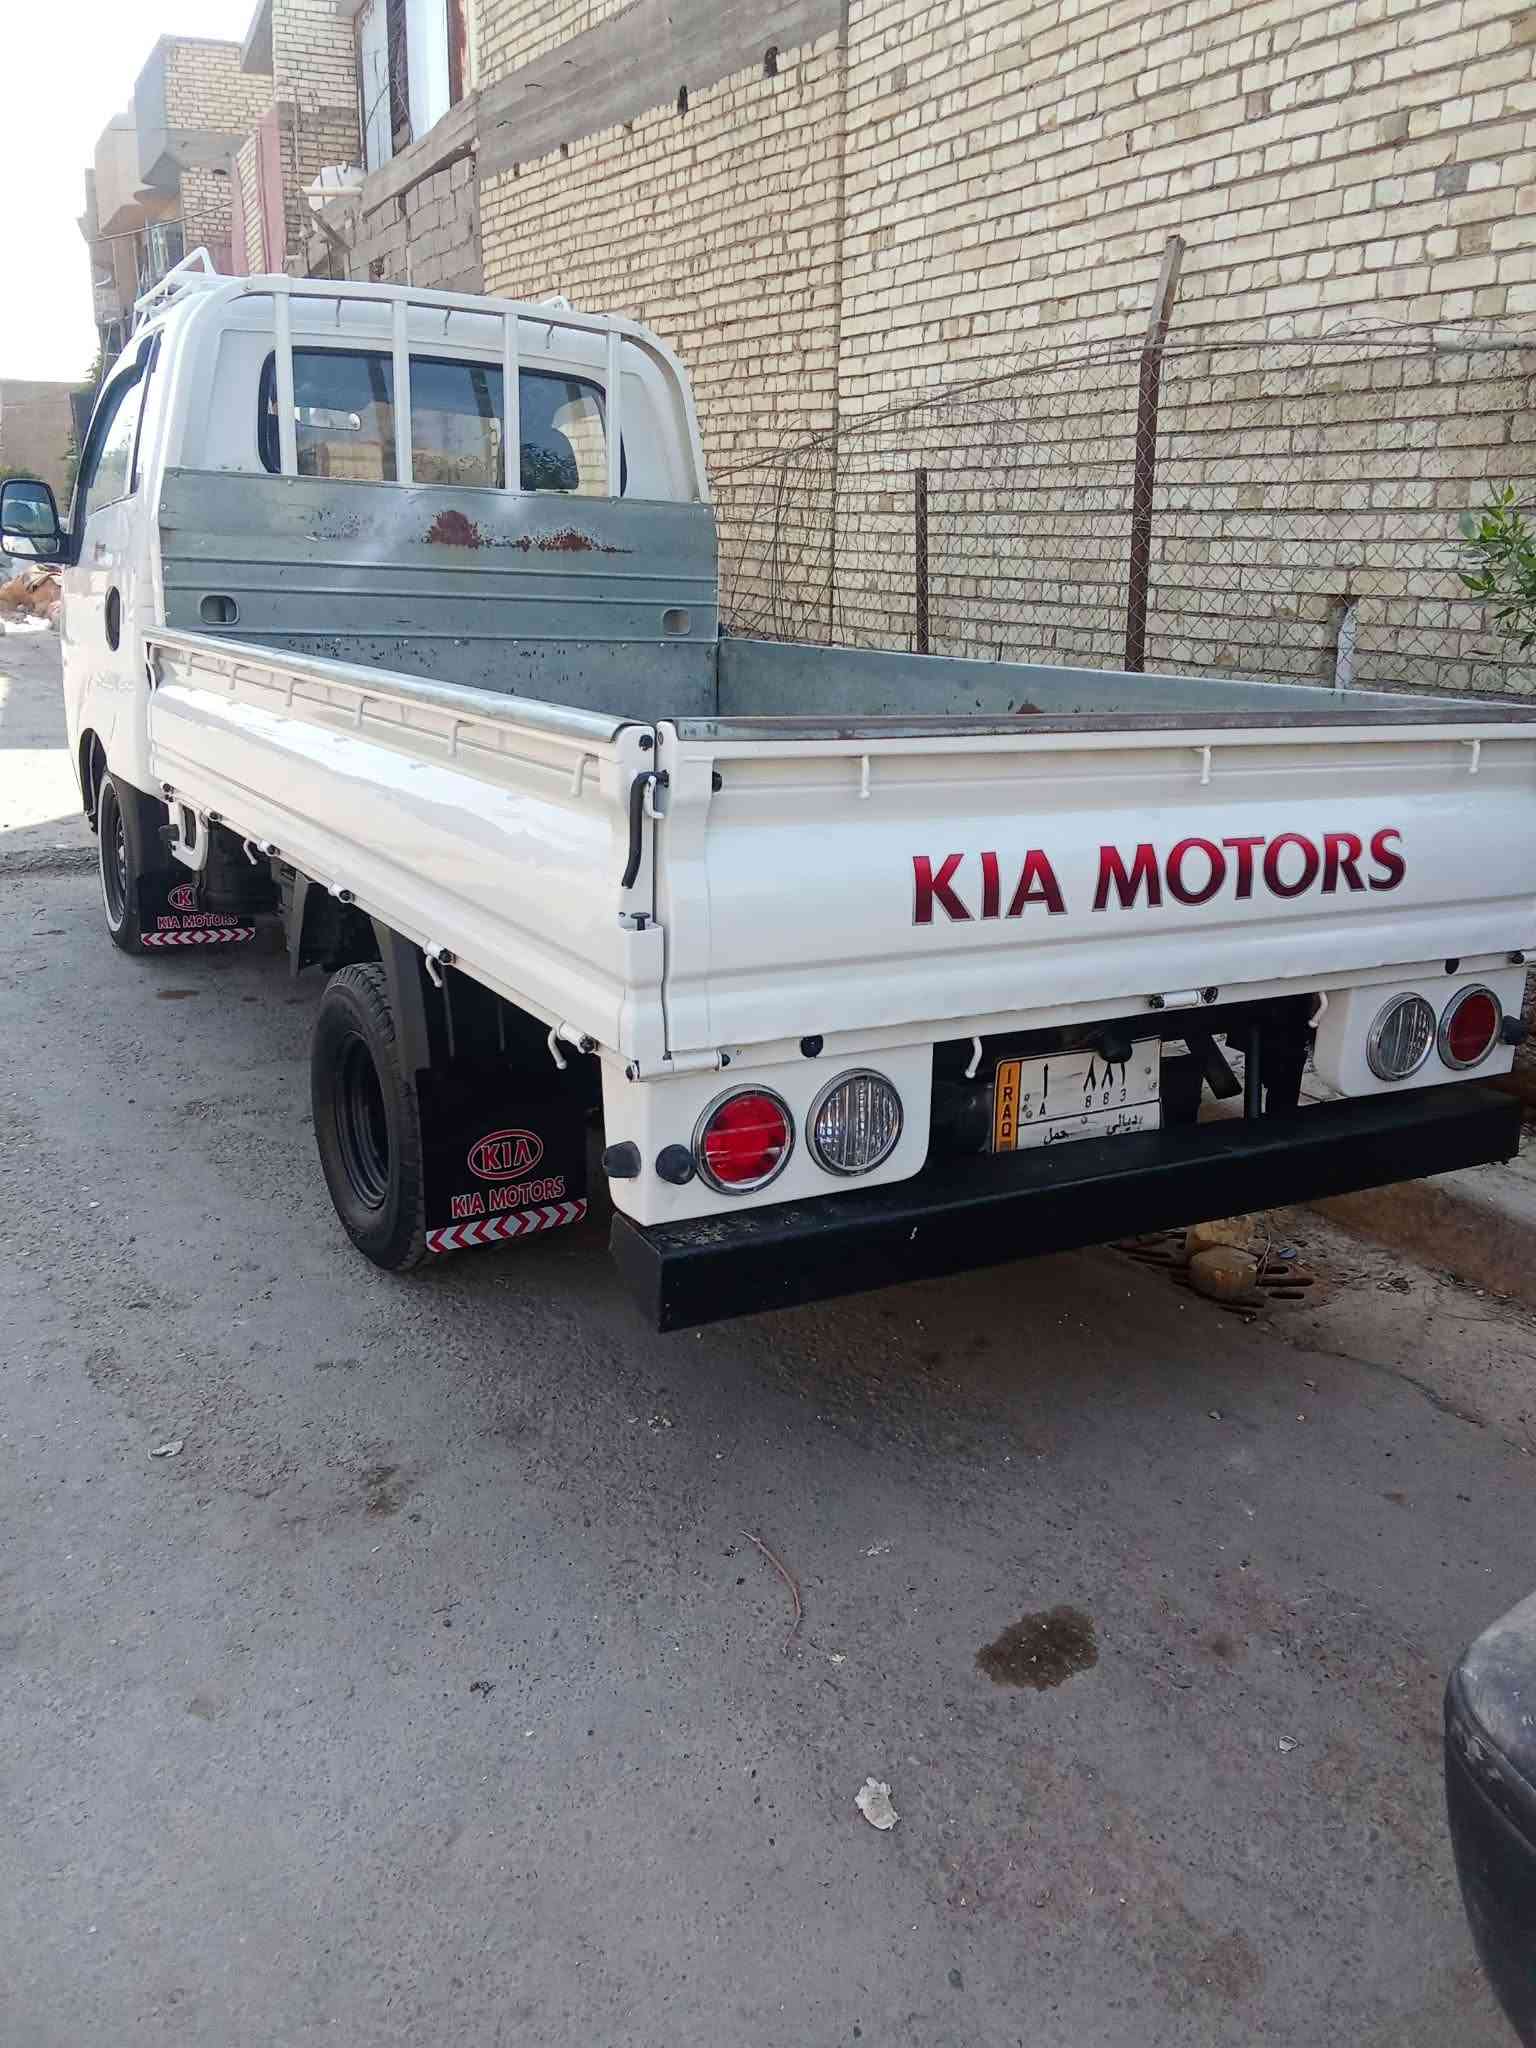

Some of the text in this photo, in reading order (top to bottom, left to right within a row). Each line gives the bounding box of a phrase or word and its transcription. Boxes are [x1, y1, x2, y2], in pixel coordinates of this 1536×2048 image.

[911, 828, 1407, 926] KIA MOTORS
[157, 916, 181, 930] KIA
[1001, 1068, 1013, 1137] IRAQ
[480, 1138, 535, 1172] KIA
[451, 1176, 567, 1220] KIA MOTORS
